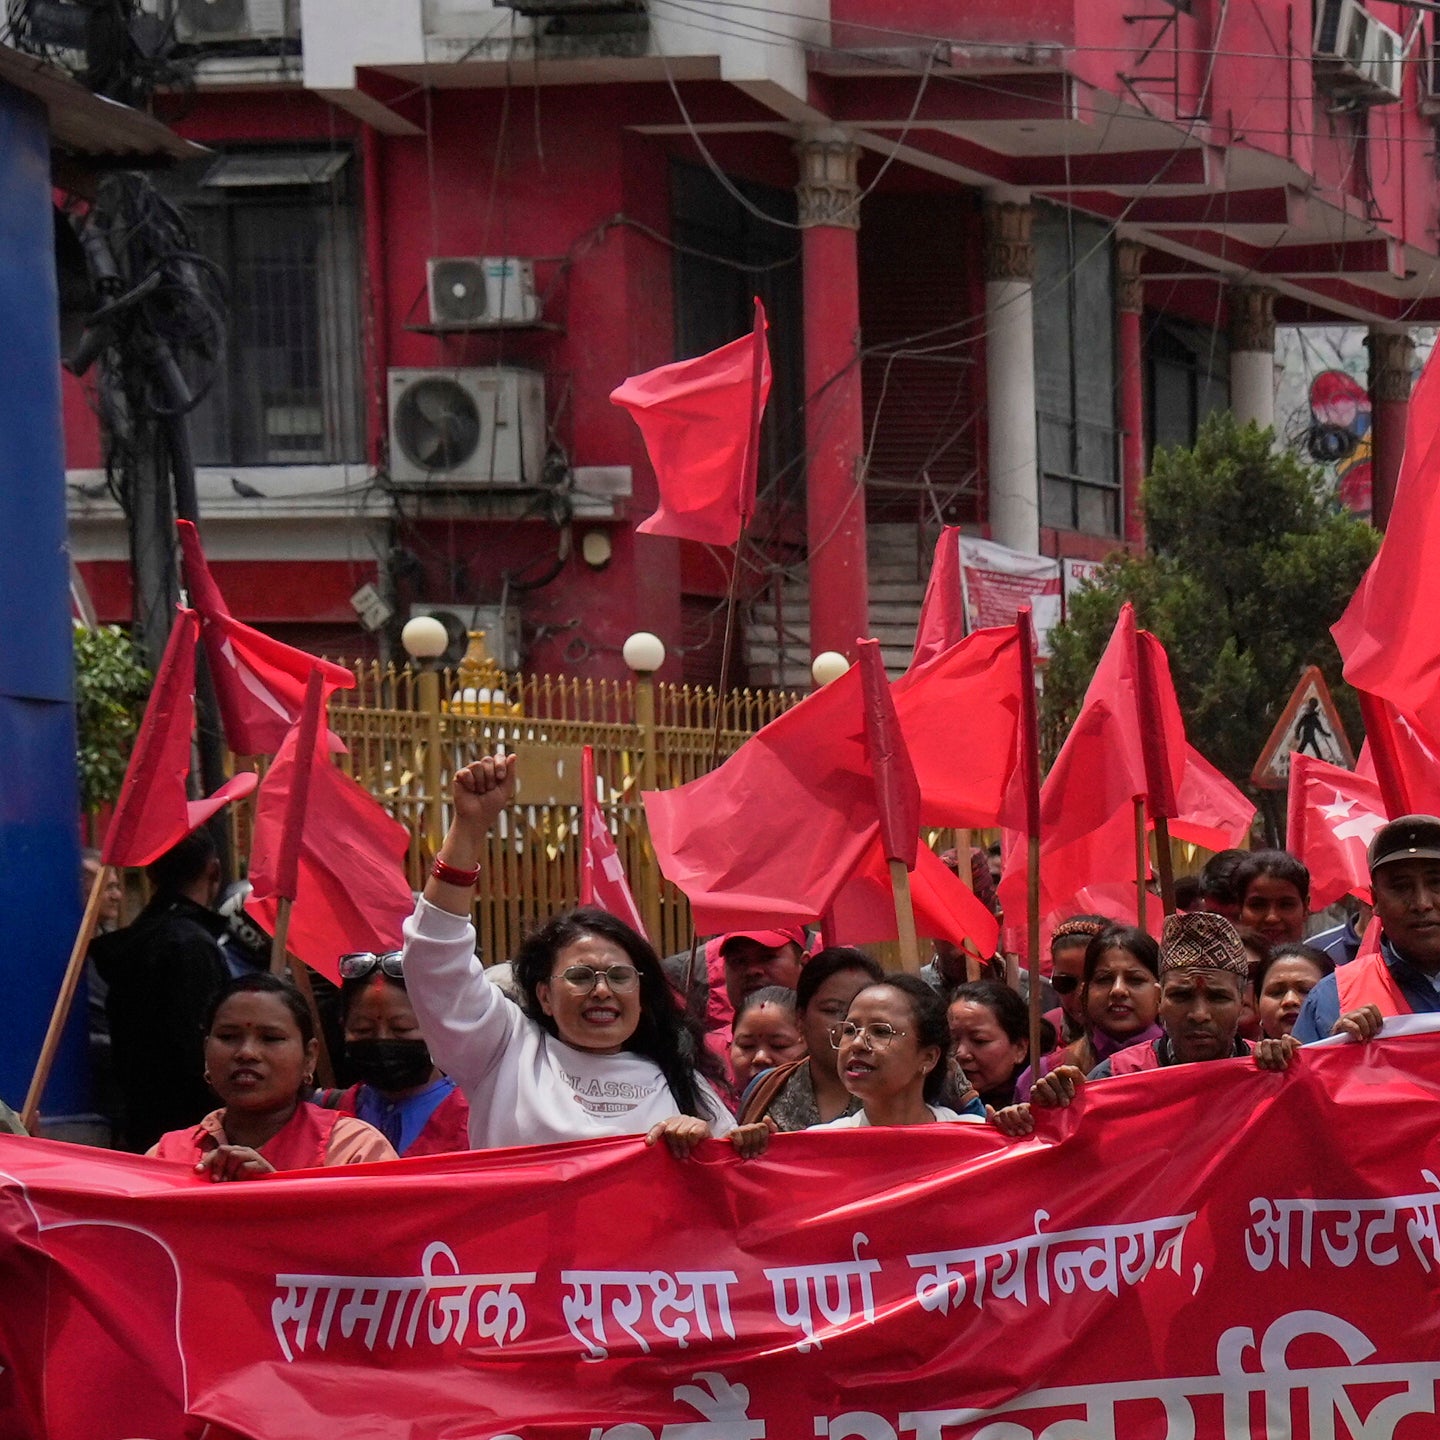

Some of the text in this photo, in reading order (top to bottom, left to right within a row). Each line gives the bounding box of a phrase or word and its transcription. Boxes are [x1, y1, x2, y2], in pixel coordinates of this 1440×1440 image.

[270, 1240, 536, 1363] सामाजिक
[560, 1268, 738, 1363] सुरक्षा
[763, 1231, 883, 1354] पूर्ण
[906, 1208, 1204, 1318] कार्यान्वयन,
